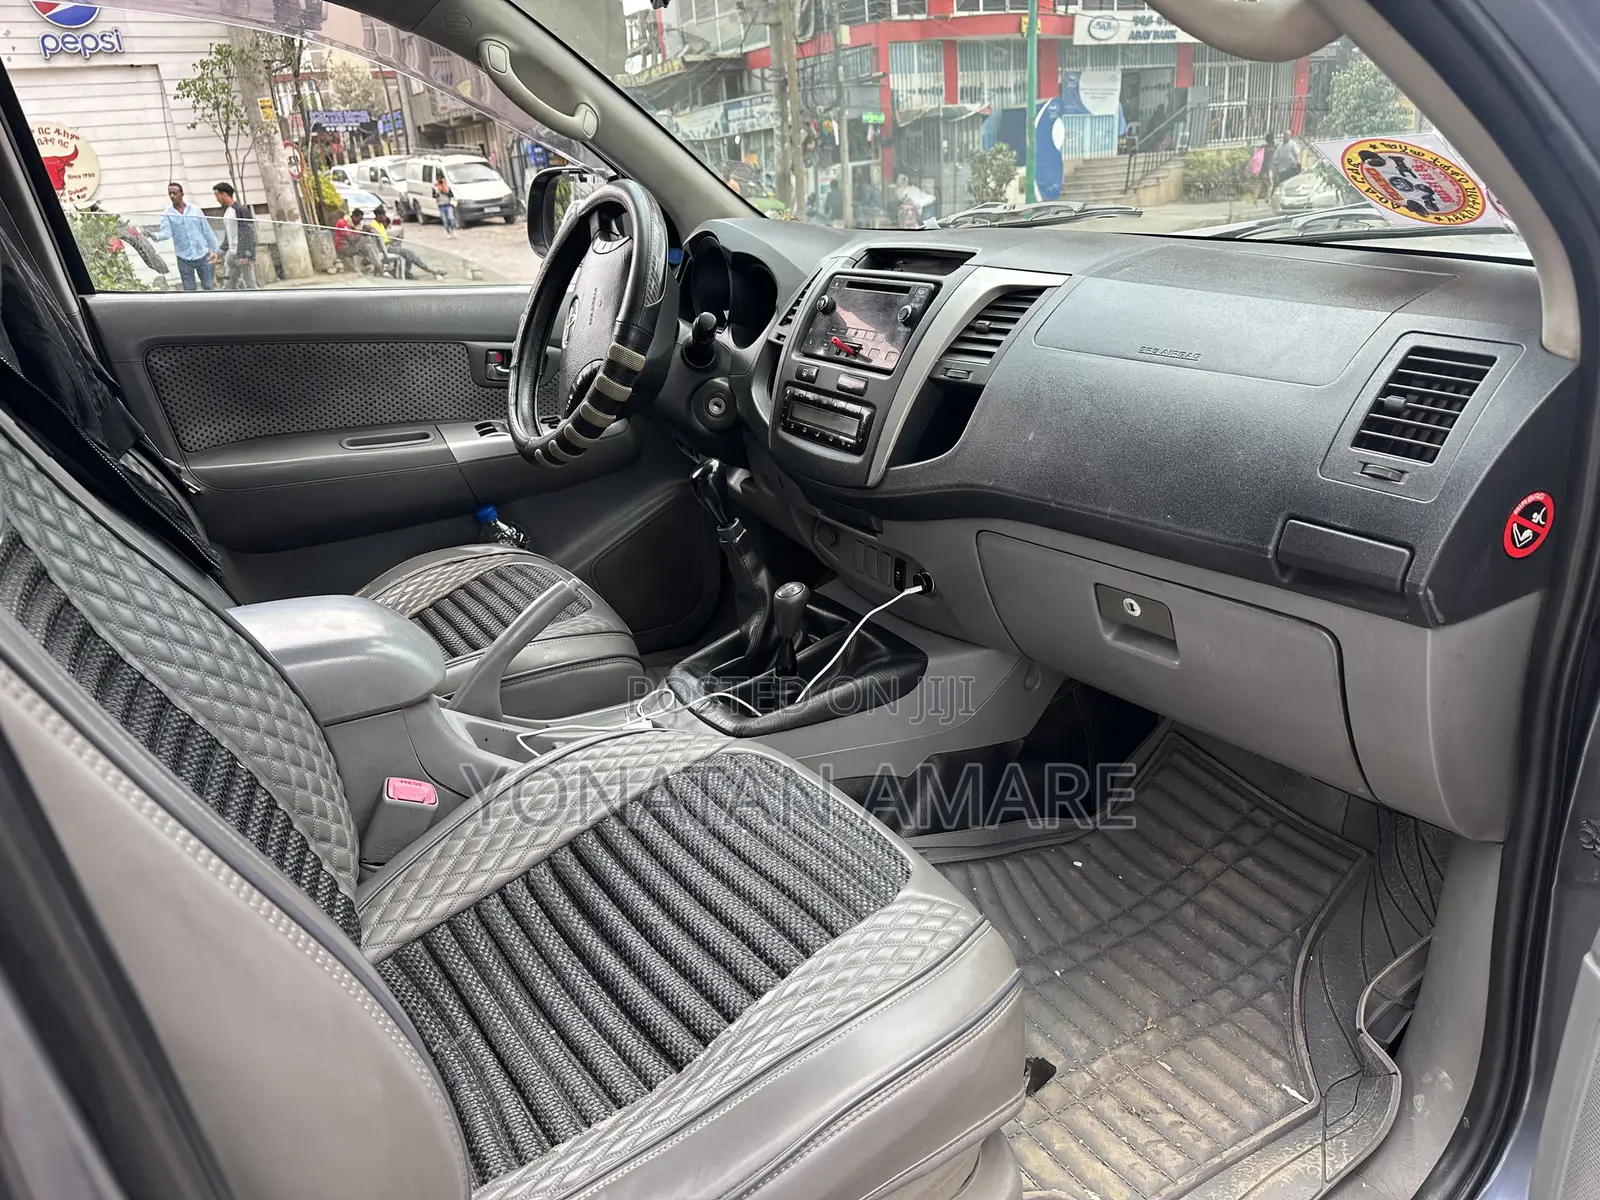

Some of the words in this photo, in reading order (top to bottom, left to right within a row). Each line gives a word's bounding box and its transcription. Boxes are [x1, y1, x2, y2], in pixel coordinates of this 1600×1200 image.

[40, 28, 124, 58] pepsi
[1128, 30, 1152, 40] ABAY
[1152, 30, 1177, 40] BANK
